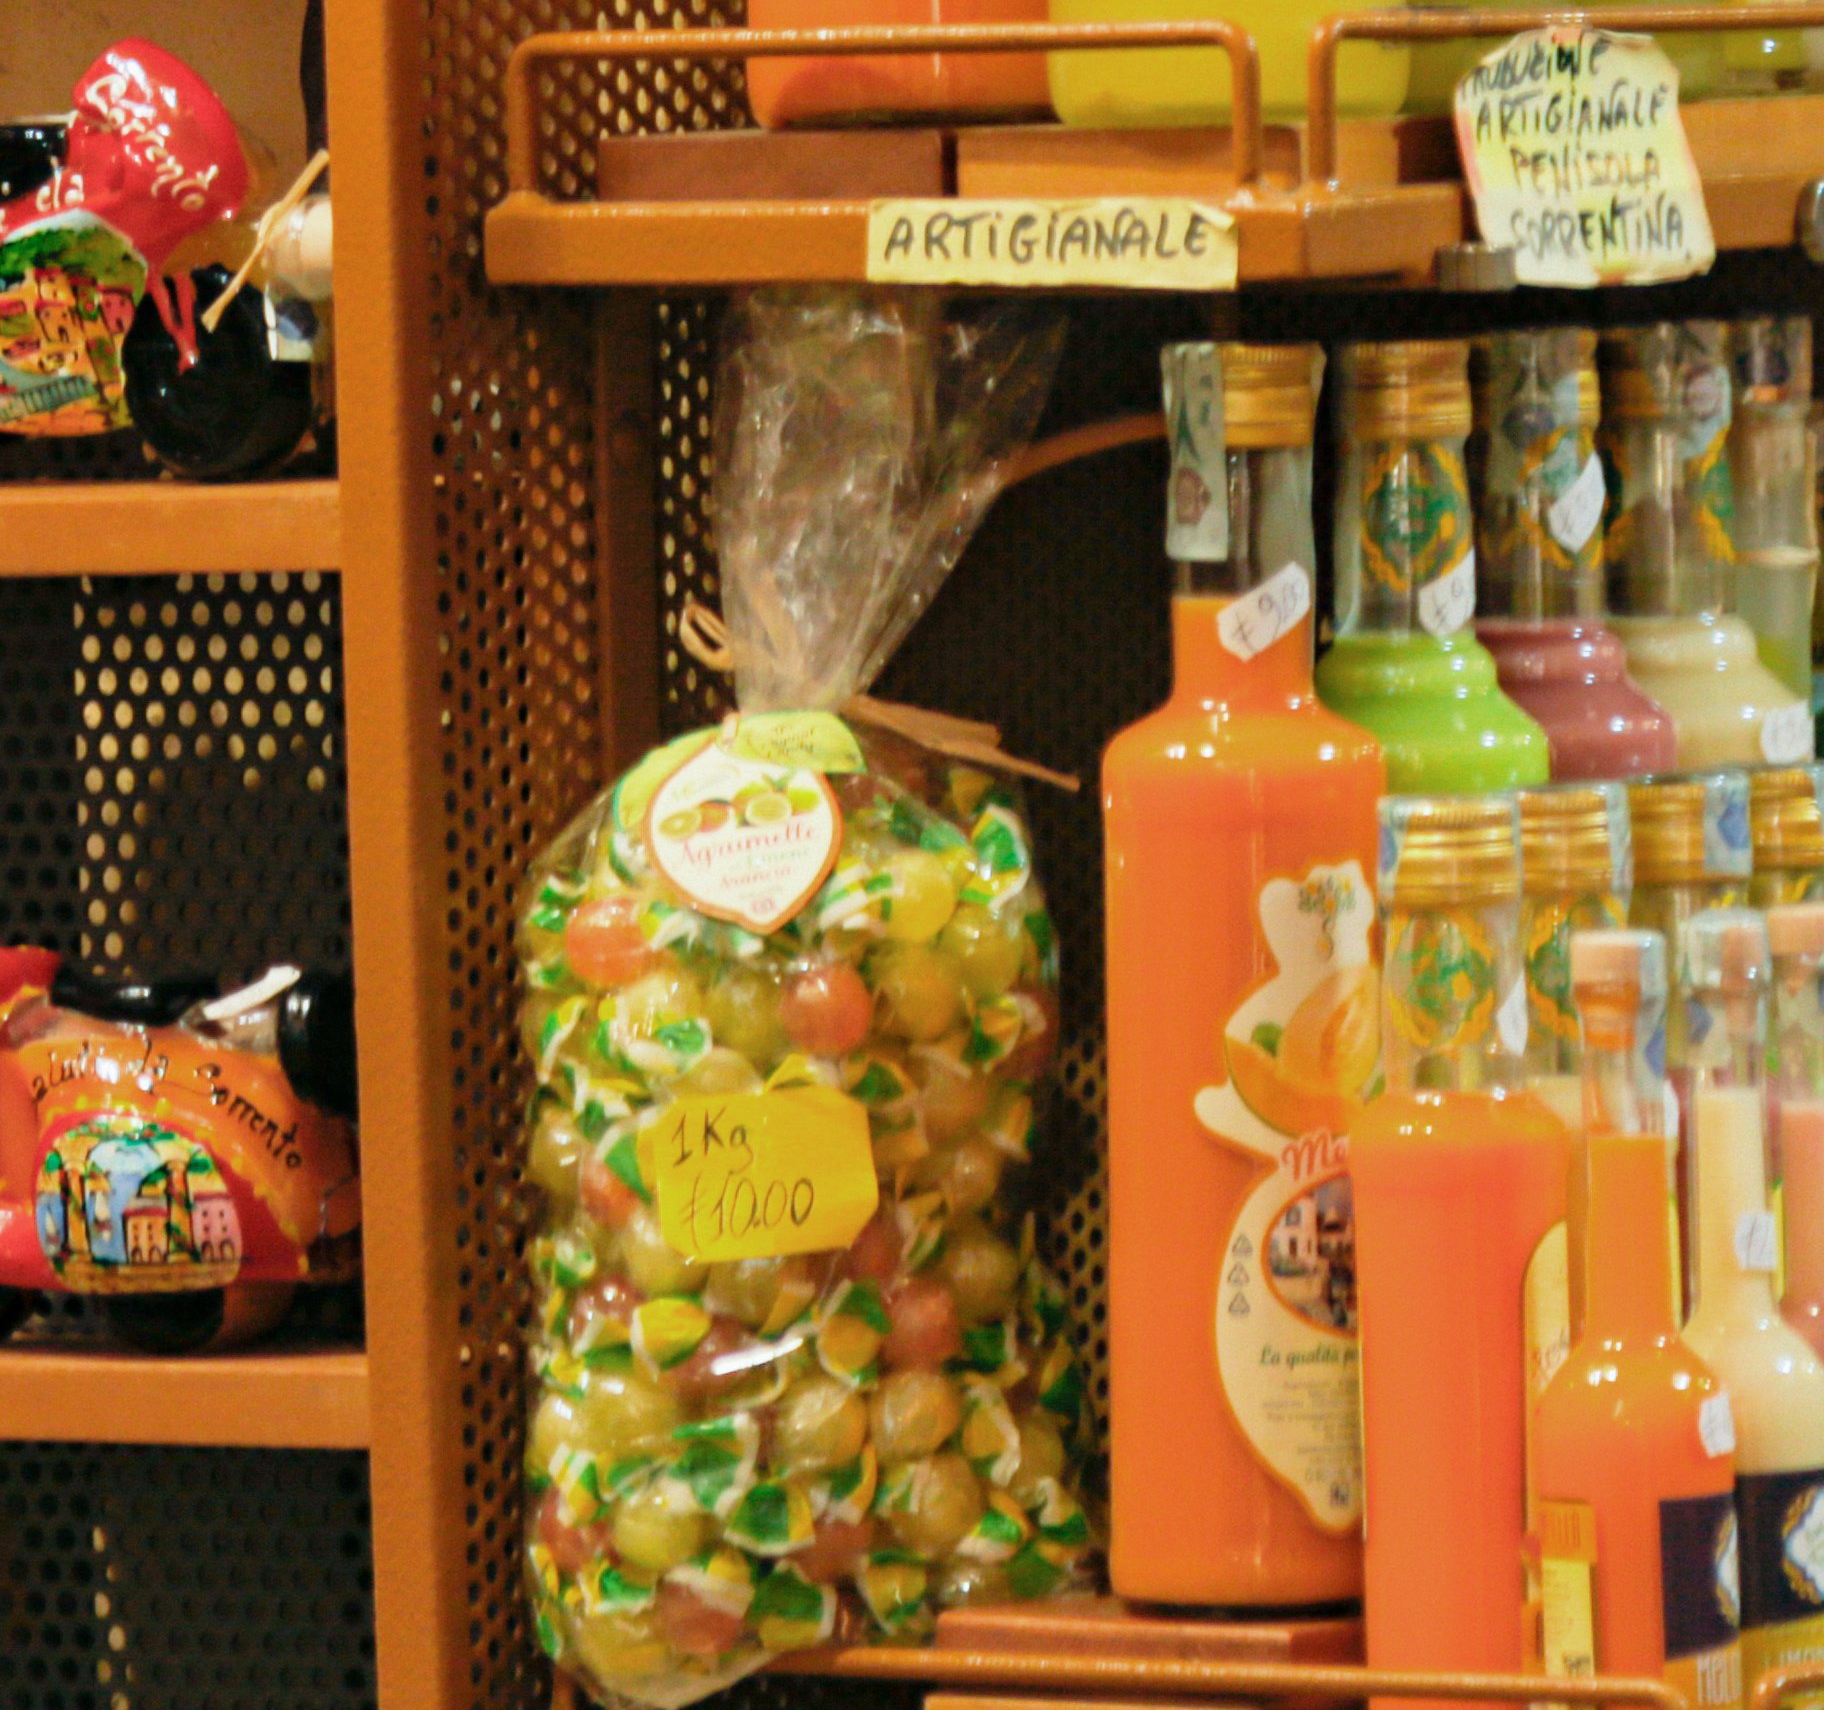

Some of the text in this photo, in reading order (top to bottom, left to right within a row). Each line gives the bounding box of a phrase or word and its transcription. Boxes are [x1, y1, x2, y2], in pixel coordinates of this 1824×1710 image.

[1476, 78, 1669, 143] ARTIGIANALE
[1509, 142, 1661, 197] PENISOLA
[883, 207, 1208, 265] ARTIGIANALE
[194, 1061, 303, 1170] Sorrento
[1257, 1345, 1282, 1368] La
